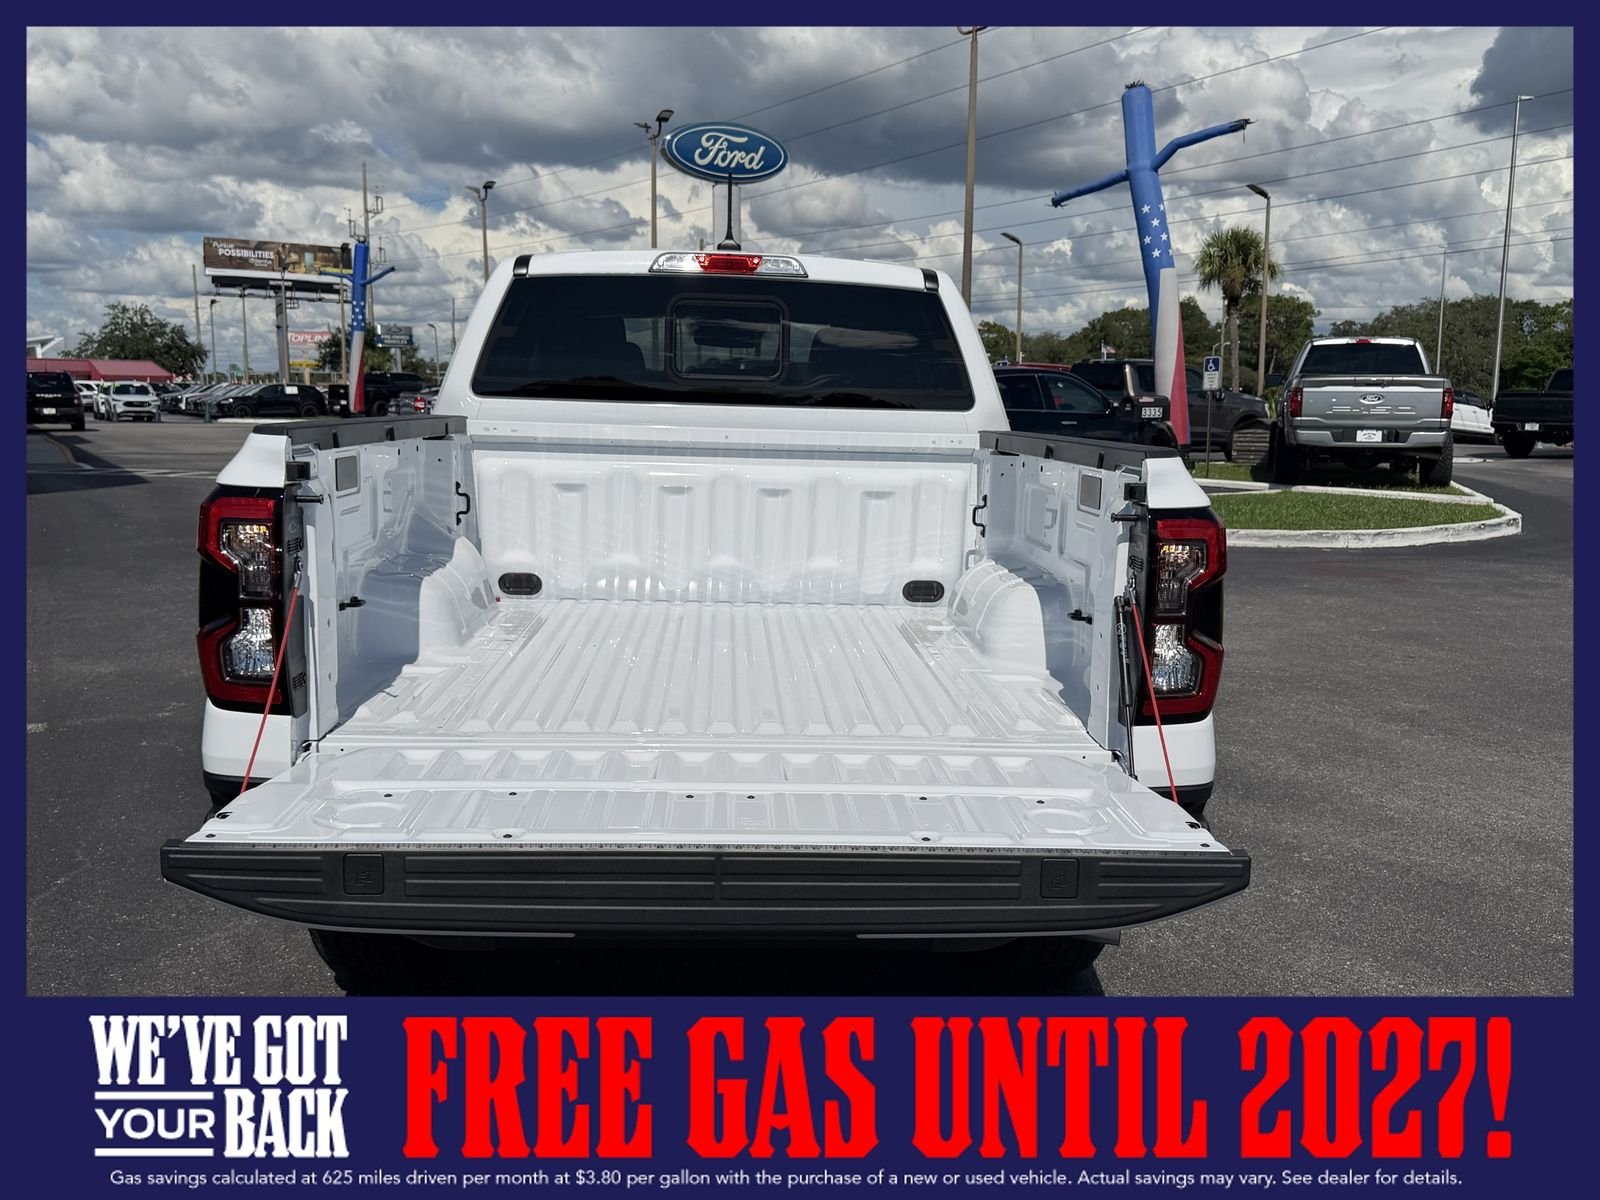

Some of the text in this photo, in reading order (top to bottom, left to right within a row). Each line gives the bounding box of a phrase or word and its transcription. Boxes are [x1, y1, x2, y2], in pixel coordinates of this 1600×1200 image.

[694, 132, 766, 170] Ford
[218, 248, 275, 259] POSSIBILITIES
[1142, 408, 1162, 417] 3335
